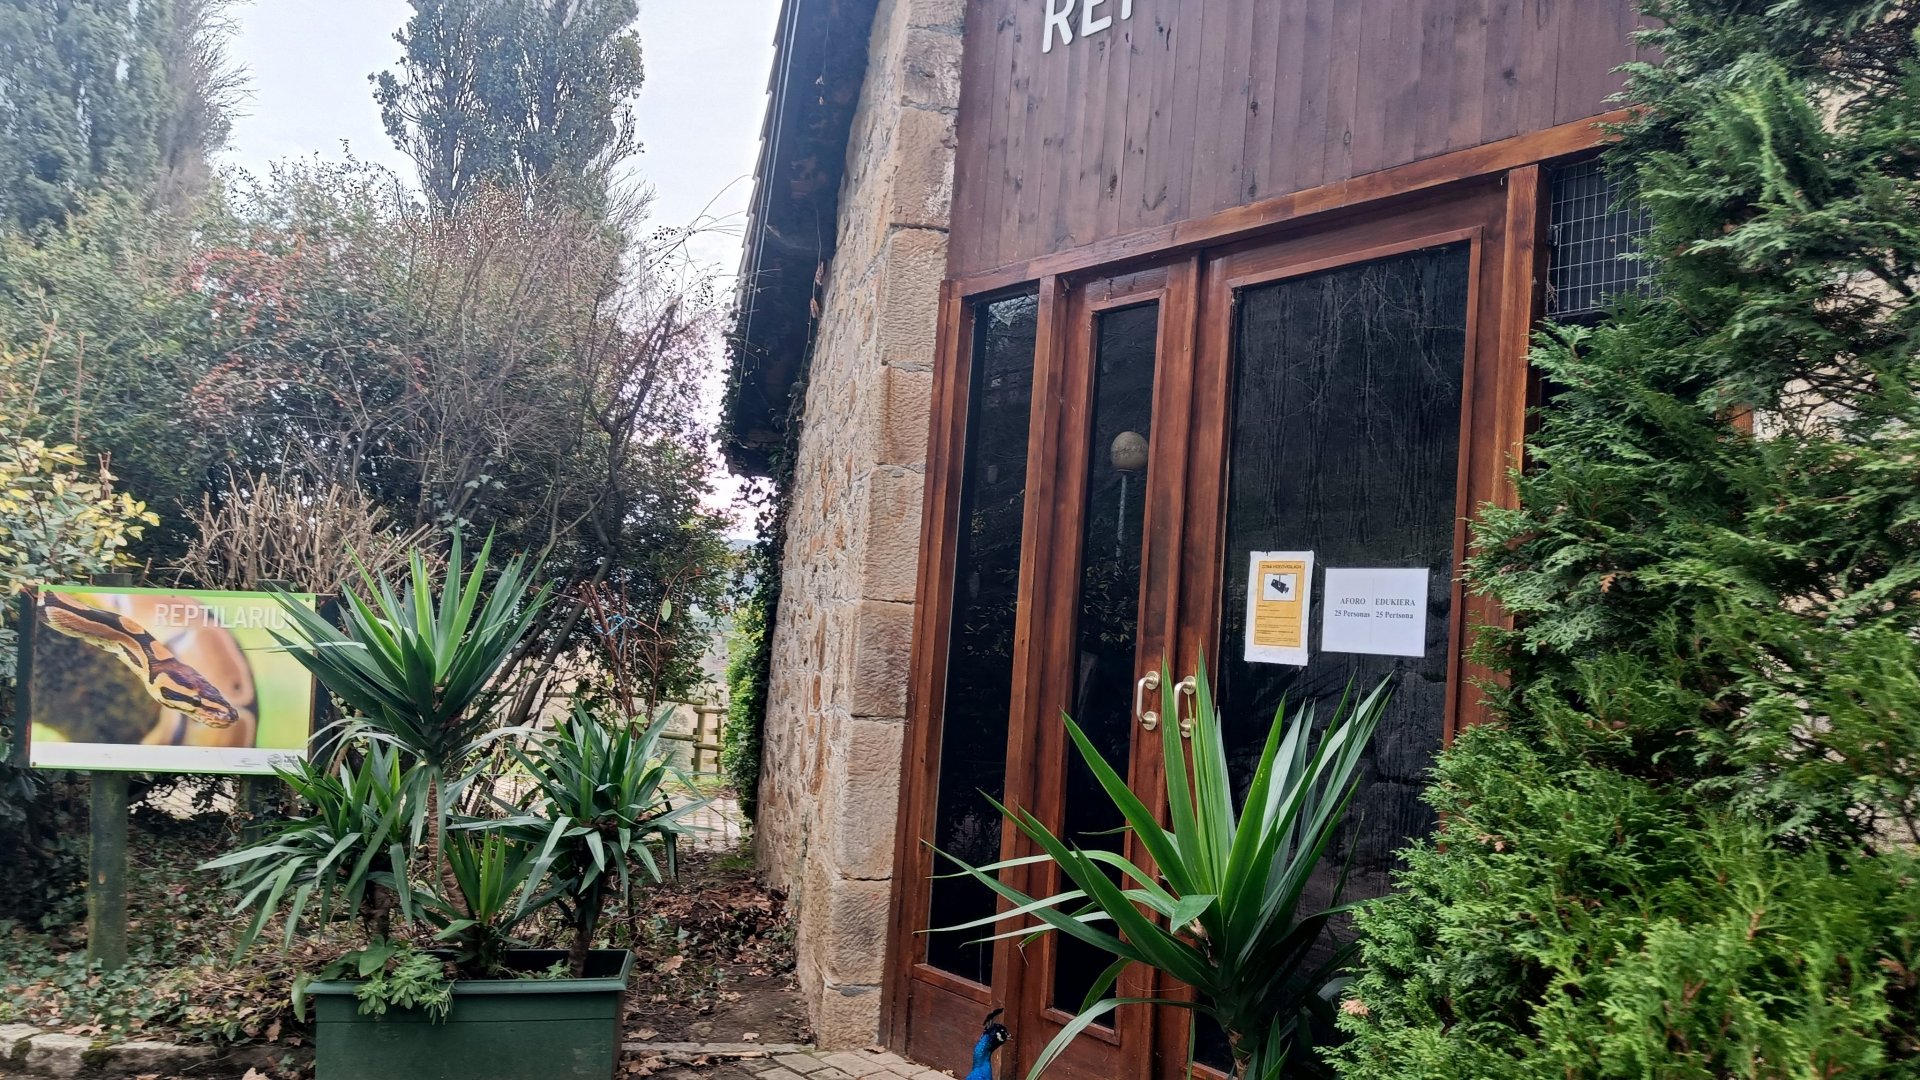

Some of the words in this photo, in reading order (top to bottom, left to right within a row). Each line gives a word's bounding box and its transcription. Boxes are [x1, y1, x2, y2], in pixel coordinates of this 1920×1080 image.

[1340, 597, 1366, 605] AFORO
[1375, 598, 1416, 607] EDUKIERA
[1334, 609, 1342, 617] 25
[1343, 610, 1370, 618] Personas
[1385, 611, 1414, 619] Pertsona
